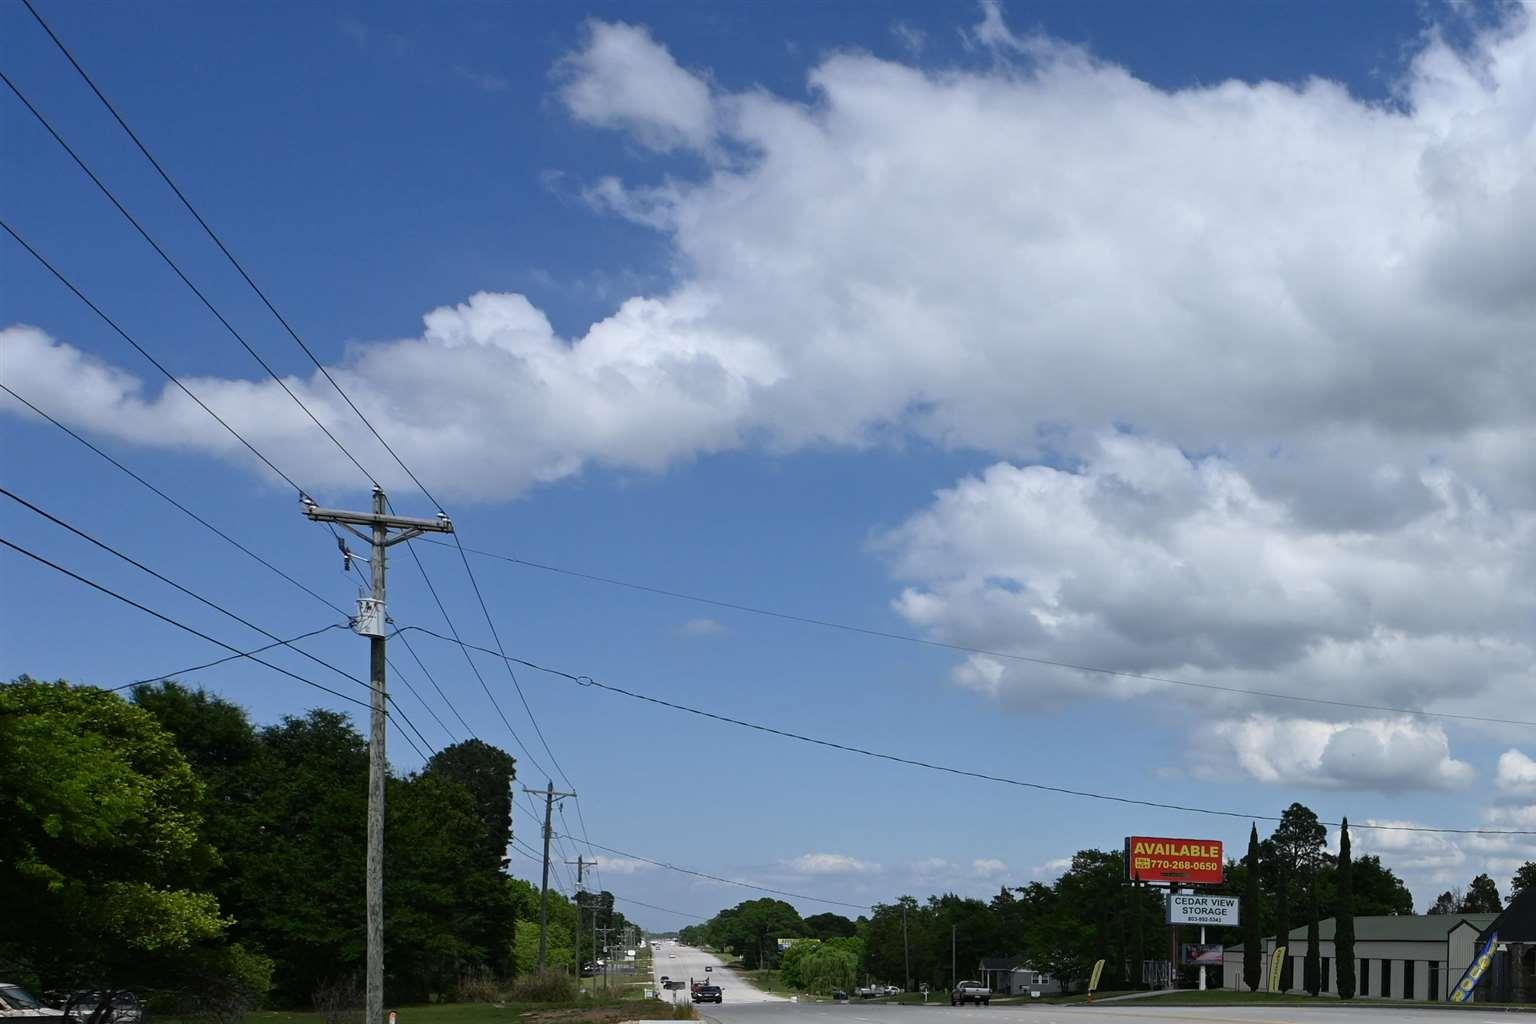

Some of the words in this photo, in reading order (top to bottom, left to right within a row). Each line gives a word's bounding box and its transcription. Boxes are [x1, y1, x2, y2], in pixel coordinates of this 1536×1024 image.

[1135, 842, 1219, 858] AVAILABLE
[1175, 897, 1208, 906] CEDAR
[1211, 898, 1235, 907] VIEW
[1183, 907, 1228, 916] STORAGE
